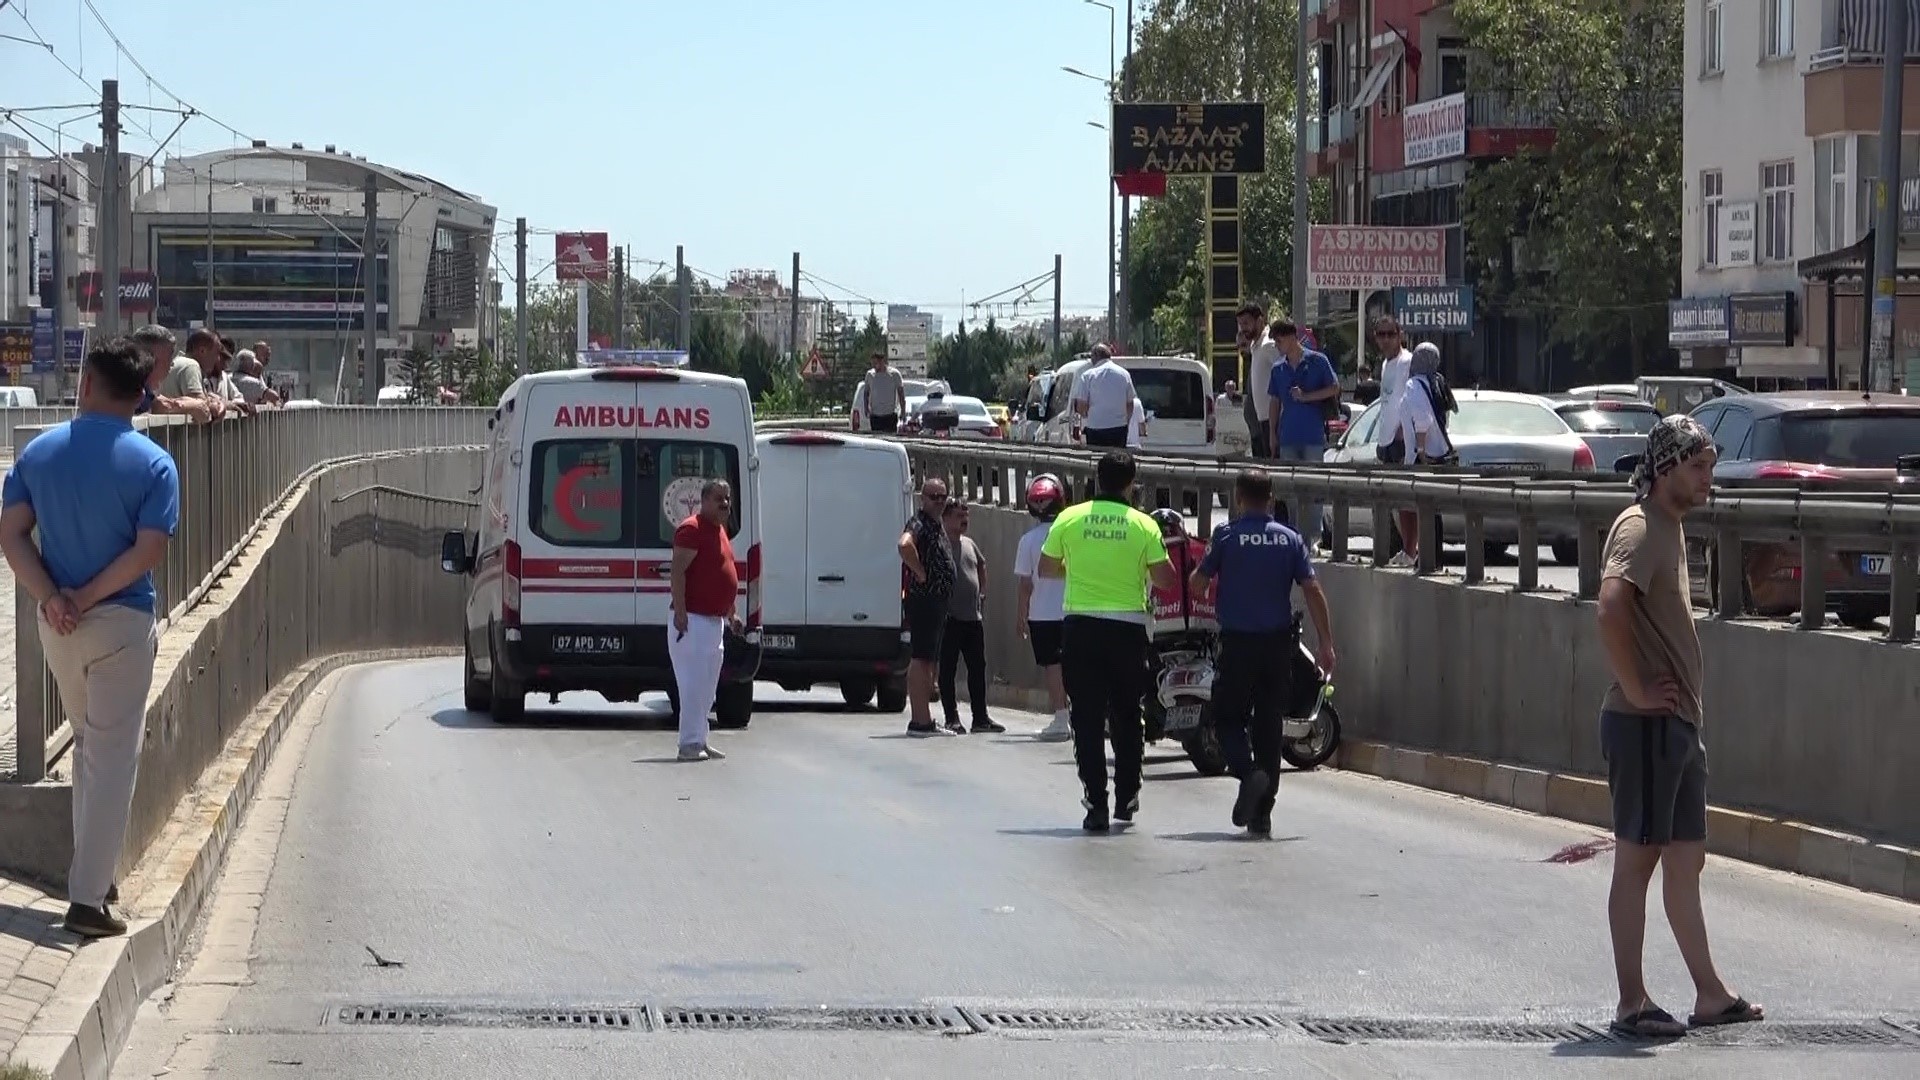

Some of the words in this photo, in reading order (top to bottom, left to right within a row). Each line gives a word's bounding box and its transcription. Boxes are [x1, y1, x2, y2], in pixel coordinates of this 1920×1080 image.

[1131, 126, 1244, 147] BAZAAR
[1140, 149, 1236, 173] AJANS
[1319, 229, 1439, 251] ASPENDOS
[1317, 252, 1370, 271] SÜRÜCÜ
[1374, 254, 1438, 272] KURSLARI
[1407, 289, 1459, 306] GARANTİ
[1400, 308, 1468, 329] İLETİŞİM
[554, 406, 710, 429] AMBULANS
[1868, 558, 1884, 571] 07
[558, 637, 572, 649] 07
